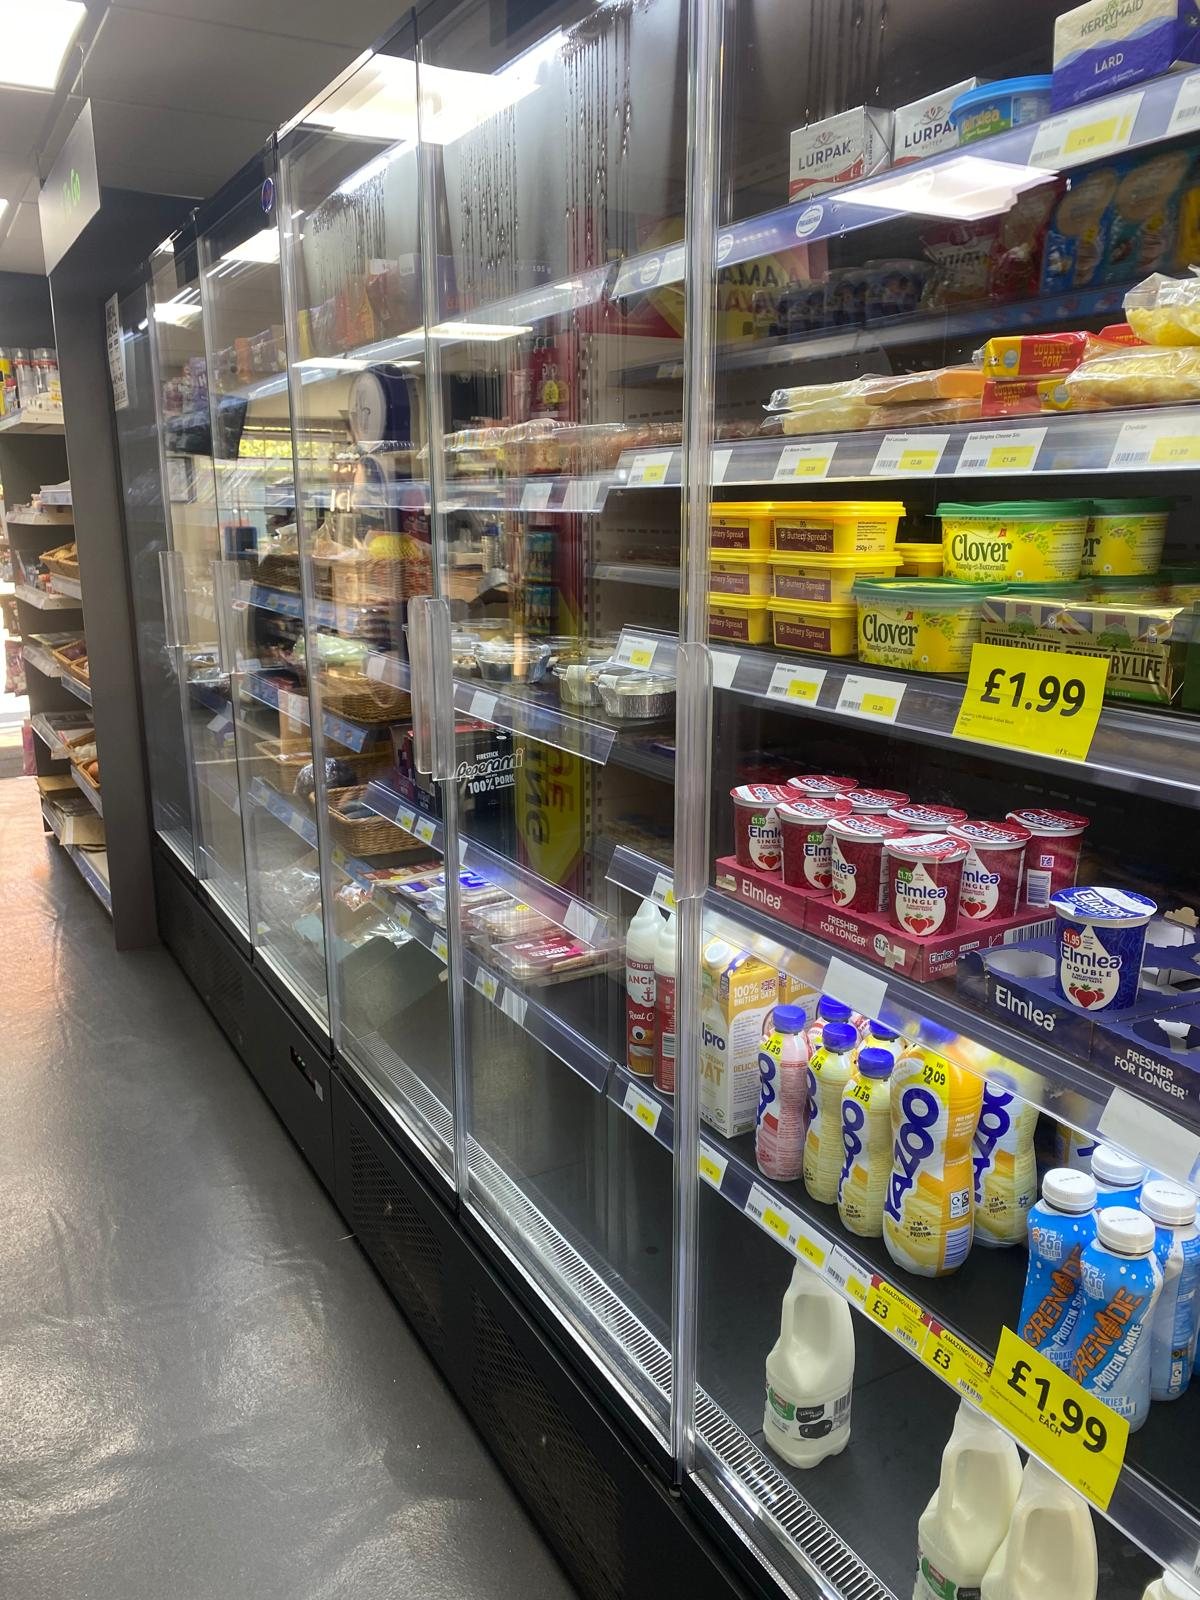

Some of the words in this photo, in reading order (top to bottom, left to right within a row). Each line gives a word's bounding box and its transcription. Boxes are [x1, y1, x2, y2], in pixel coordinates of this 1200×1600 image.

[1080, 0, 1144, 36] KERRYMAID
[1095, 53, 1124, 74] LARD
[905, 118, 956, 149] LURPA
[798, 138, 852, 170] LURPAK
[1033, 343, 1071, 355] COUNTRY
[1041, 355, 1062, 368] COW
[725, 529, 744, 539] Spread
[805, 532, 828, 543] Spread
[855, 544, 868, 552] 250g
[951, 534, 1012, 563] Clover
[862, 614, 918, 647] Clover
[1133, 656, 1161, 680] LIFE
[980, 667, 1086, 717] £1.99
[455, 747, 525, 782] Peperami
[468, 780, 494, 794] 100%
[495, 773, 515, 785] PORK
[751, 816, 766, 826] £1.75
[805, 844, 831, 857] Elm
[897, 870, 913, 880] £1.75
[963, 871, 1000, 885] mlea
[741, 879, 782, 910] Elmlea
[896, 881, 947, 899] Elmlea
[962, 882, 990, 891] INGLE
[902, 897, 938, 906] SINGLE
[820, 921, 834, 934] FOR
[835, 926, 866, 947] LONGER
[827, 914, 859, 934] FRESHER
[1063, 931, 1080, 946] £1.95
[631, 962, 655, 970] ORIGI
[929, 950, 955, 964] Elmlea
[1061, 943, 1121, 970] Elmlea
[628, 975, 655, 985] ANCH
[1066, 963, 1112, 978] DOUBLE
[734, 982, 759, 999] 100%
[734, 993, 759, 1007] BRITISH
[760, 990, 776, 999] OATS
[629, 1010, 645, 1021] Real
[995, 984, 1056, 1032] Elmlea
[702, 1021, 726, 1051] lpro
[733, 1061, 759, 1072] DELICIO
[922, 1064, 946, 1086] £2.09
[1126, 1048, 1174, 1081] FRESHER
[1114, 1055, 1136, 1076] FOR
[1138, 1068, 1186, 1101] LONGER
[853, 1084, 870, 1103] £1.39
[885, 1086, 940, 1223] YAZOO
[909, 1230, 931, 1238] PROTEIN
[1039, 1233, 1061, 1251] 25G
[881, 1286, 919, 1316] AMAZINGVALUE
[1023, 1244, 1082, 1348] GRENAD
[872, 1300, 889, 1319] £3
[1052, 1308, 1079, 1347] PROTEIN
[1071, 1287, 1144, 1384] GRENADE
[932, 1348, 951, 1370] £3
[943, 1334, 985, 1369] AMAZINGVALUE
[1049, 1350, 1074, 1361] COOKIE
[1093, 1346, 1128, 1393] PROTEIN
[1119, 1323, 1143, 1361] SHAKE
[1007, 1360, 1108, 1454] £1.99
[1038, 1414, 1062, 1438] EACH
